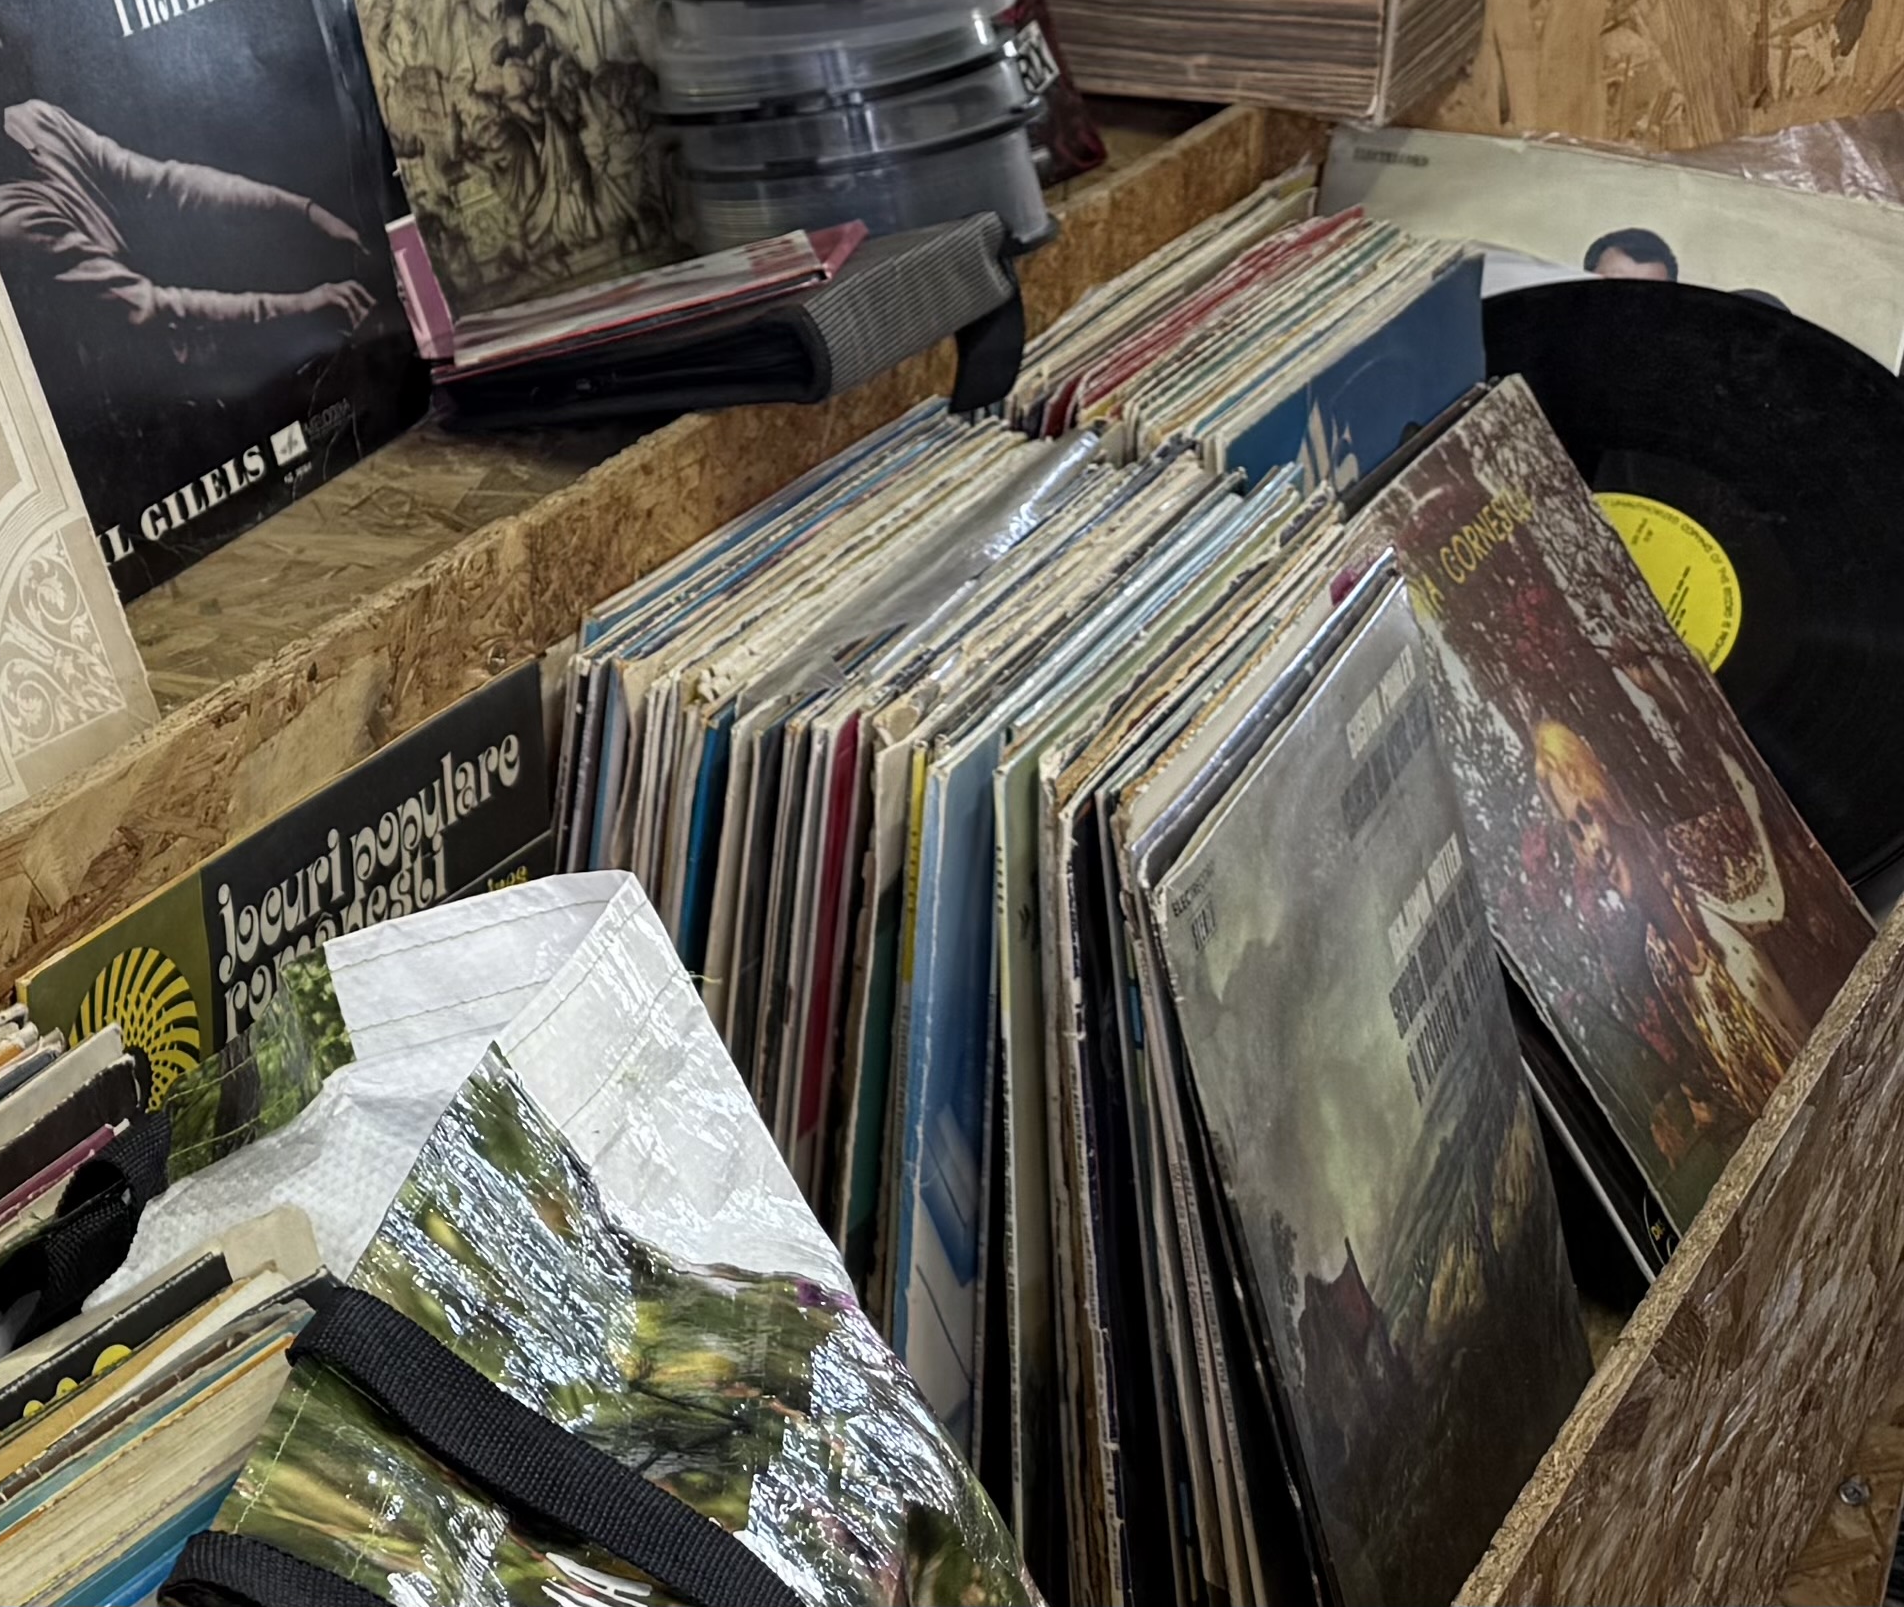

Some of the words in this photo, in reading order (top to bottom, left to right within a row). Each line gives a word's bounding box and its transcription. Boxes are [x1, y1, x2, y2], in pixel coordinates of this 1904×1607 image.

[139, 444, 266, 543] GILELS
[219, 828, 343, 984] jocuri
[350, 732, 521, 882] populare
